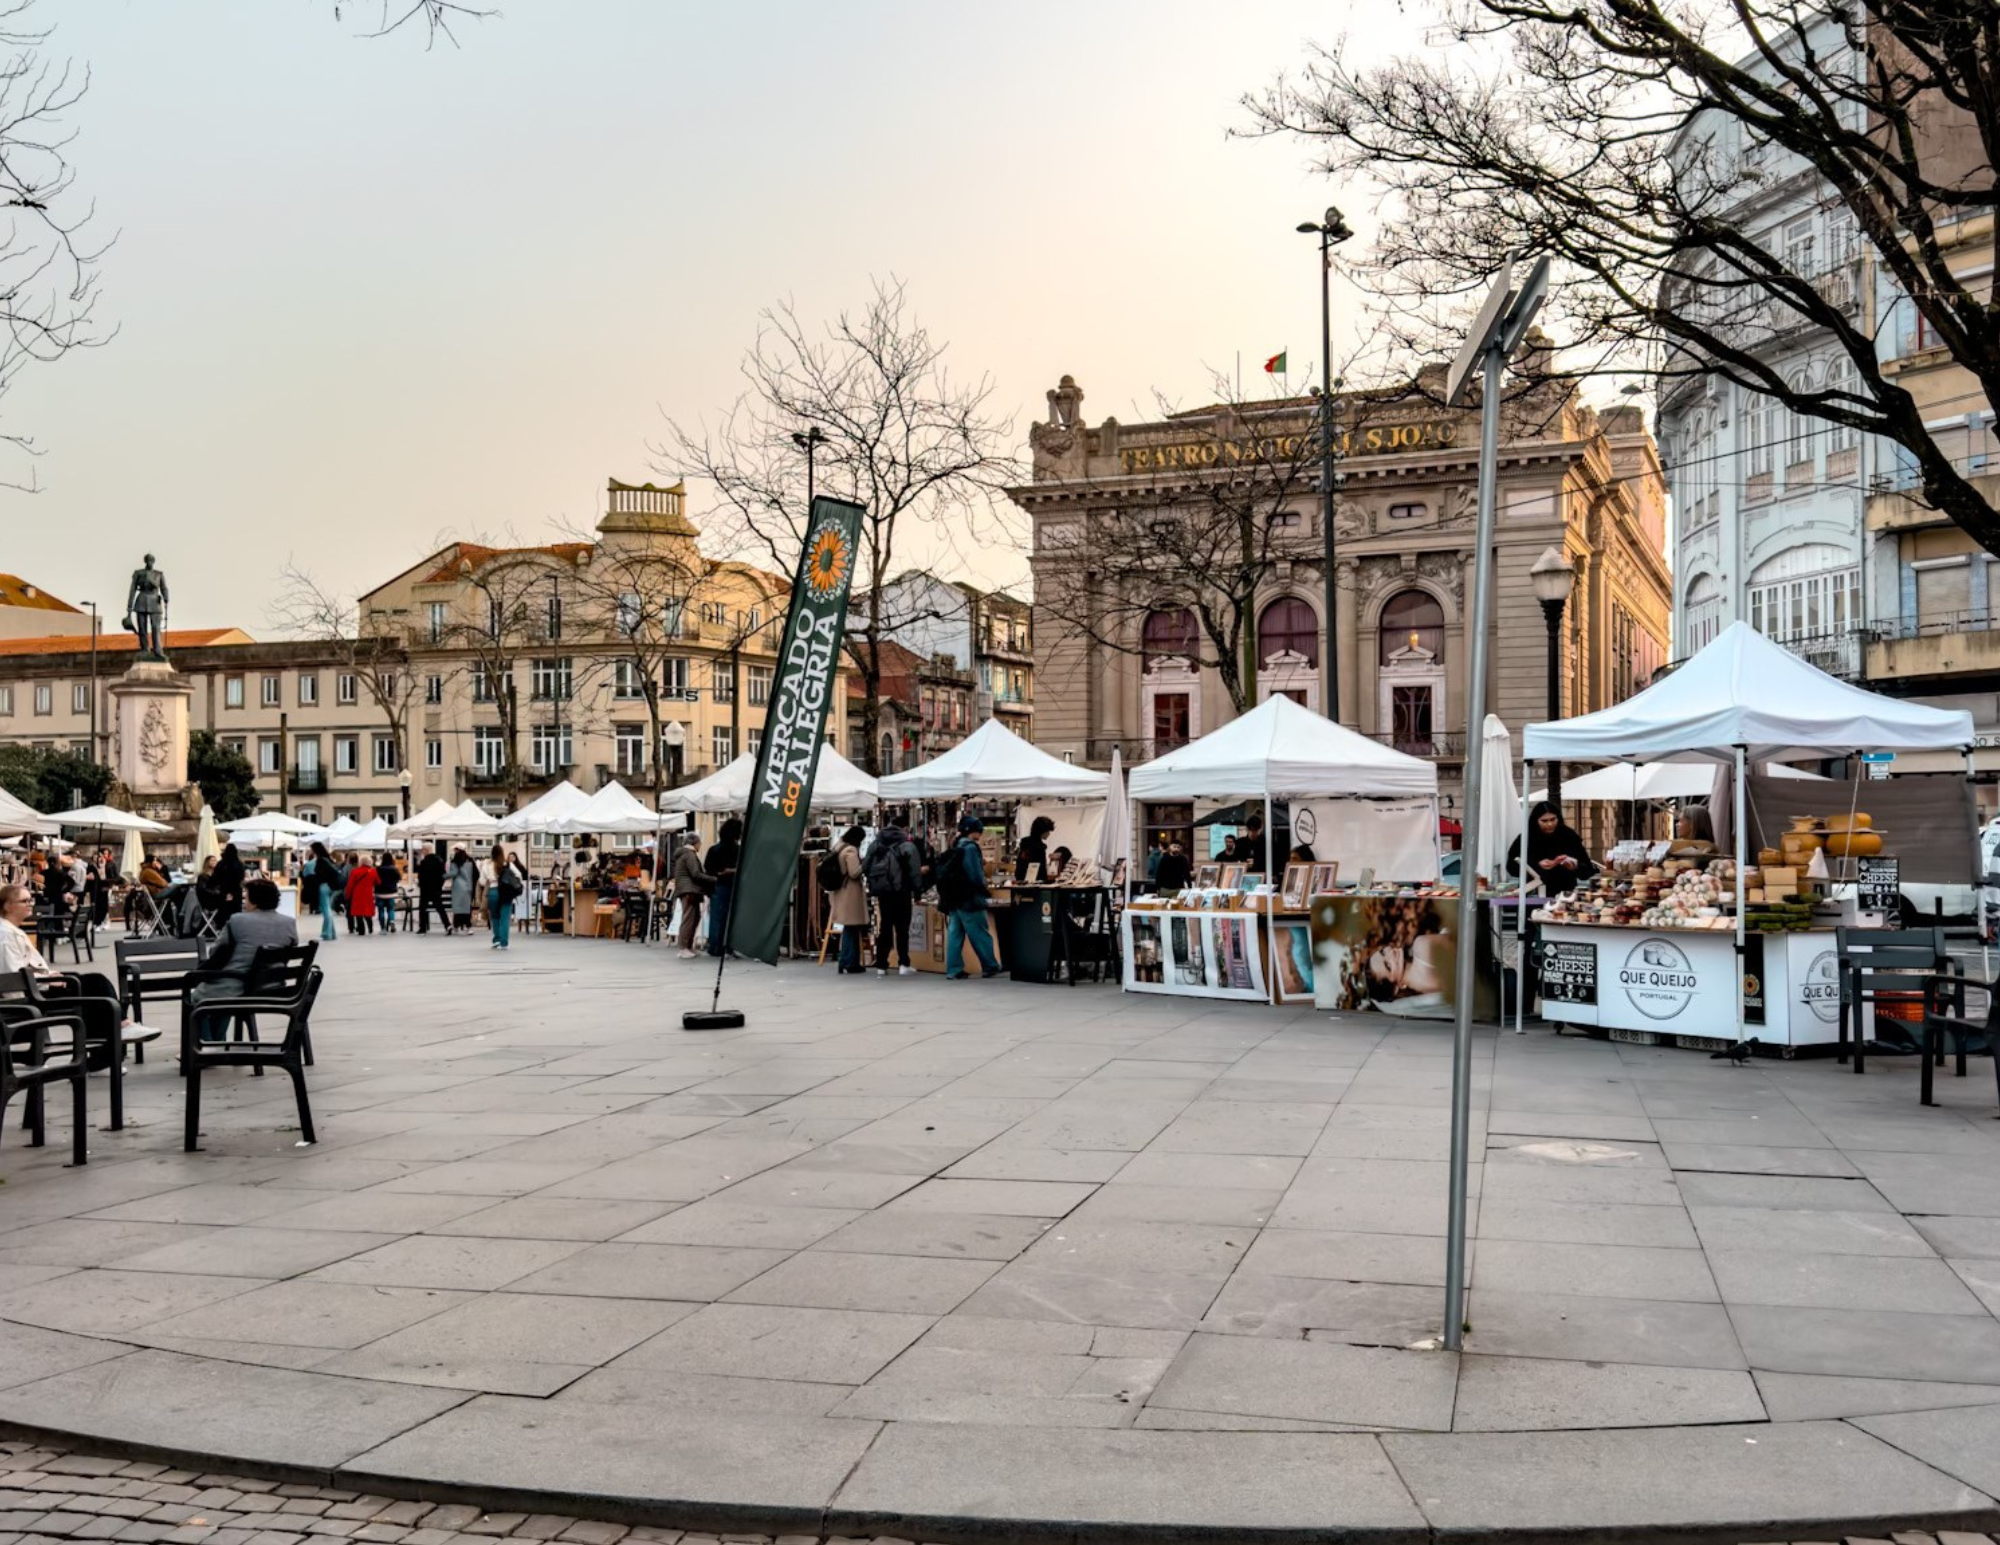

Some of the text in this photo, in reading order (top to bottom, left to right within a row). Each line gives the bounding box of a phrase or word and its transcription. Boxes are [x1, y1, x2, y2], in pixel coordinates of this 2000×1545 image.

[1121, 442, 1219, 469] TEATRO
[761, 608, 815, 809] MERCADO
[782, 611, 838, 817] da ALEGRIA
[1860, 872, 1898, 884] CHEESE
[1544, 958, 1594, 974] CHEESE
[1620, 970, 1697, 988] QUE QUEIJO
[1640, 992, 1678, 1001] PORTUGAL
[1803, 987, 1822, 999] QUE
